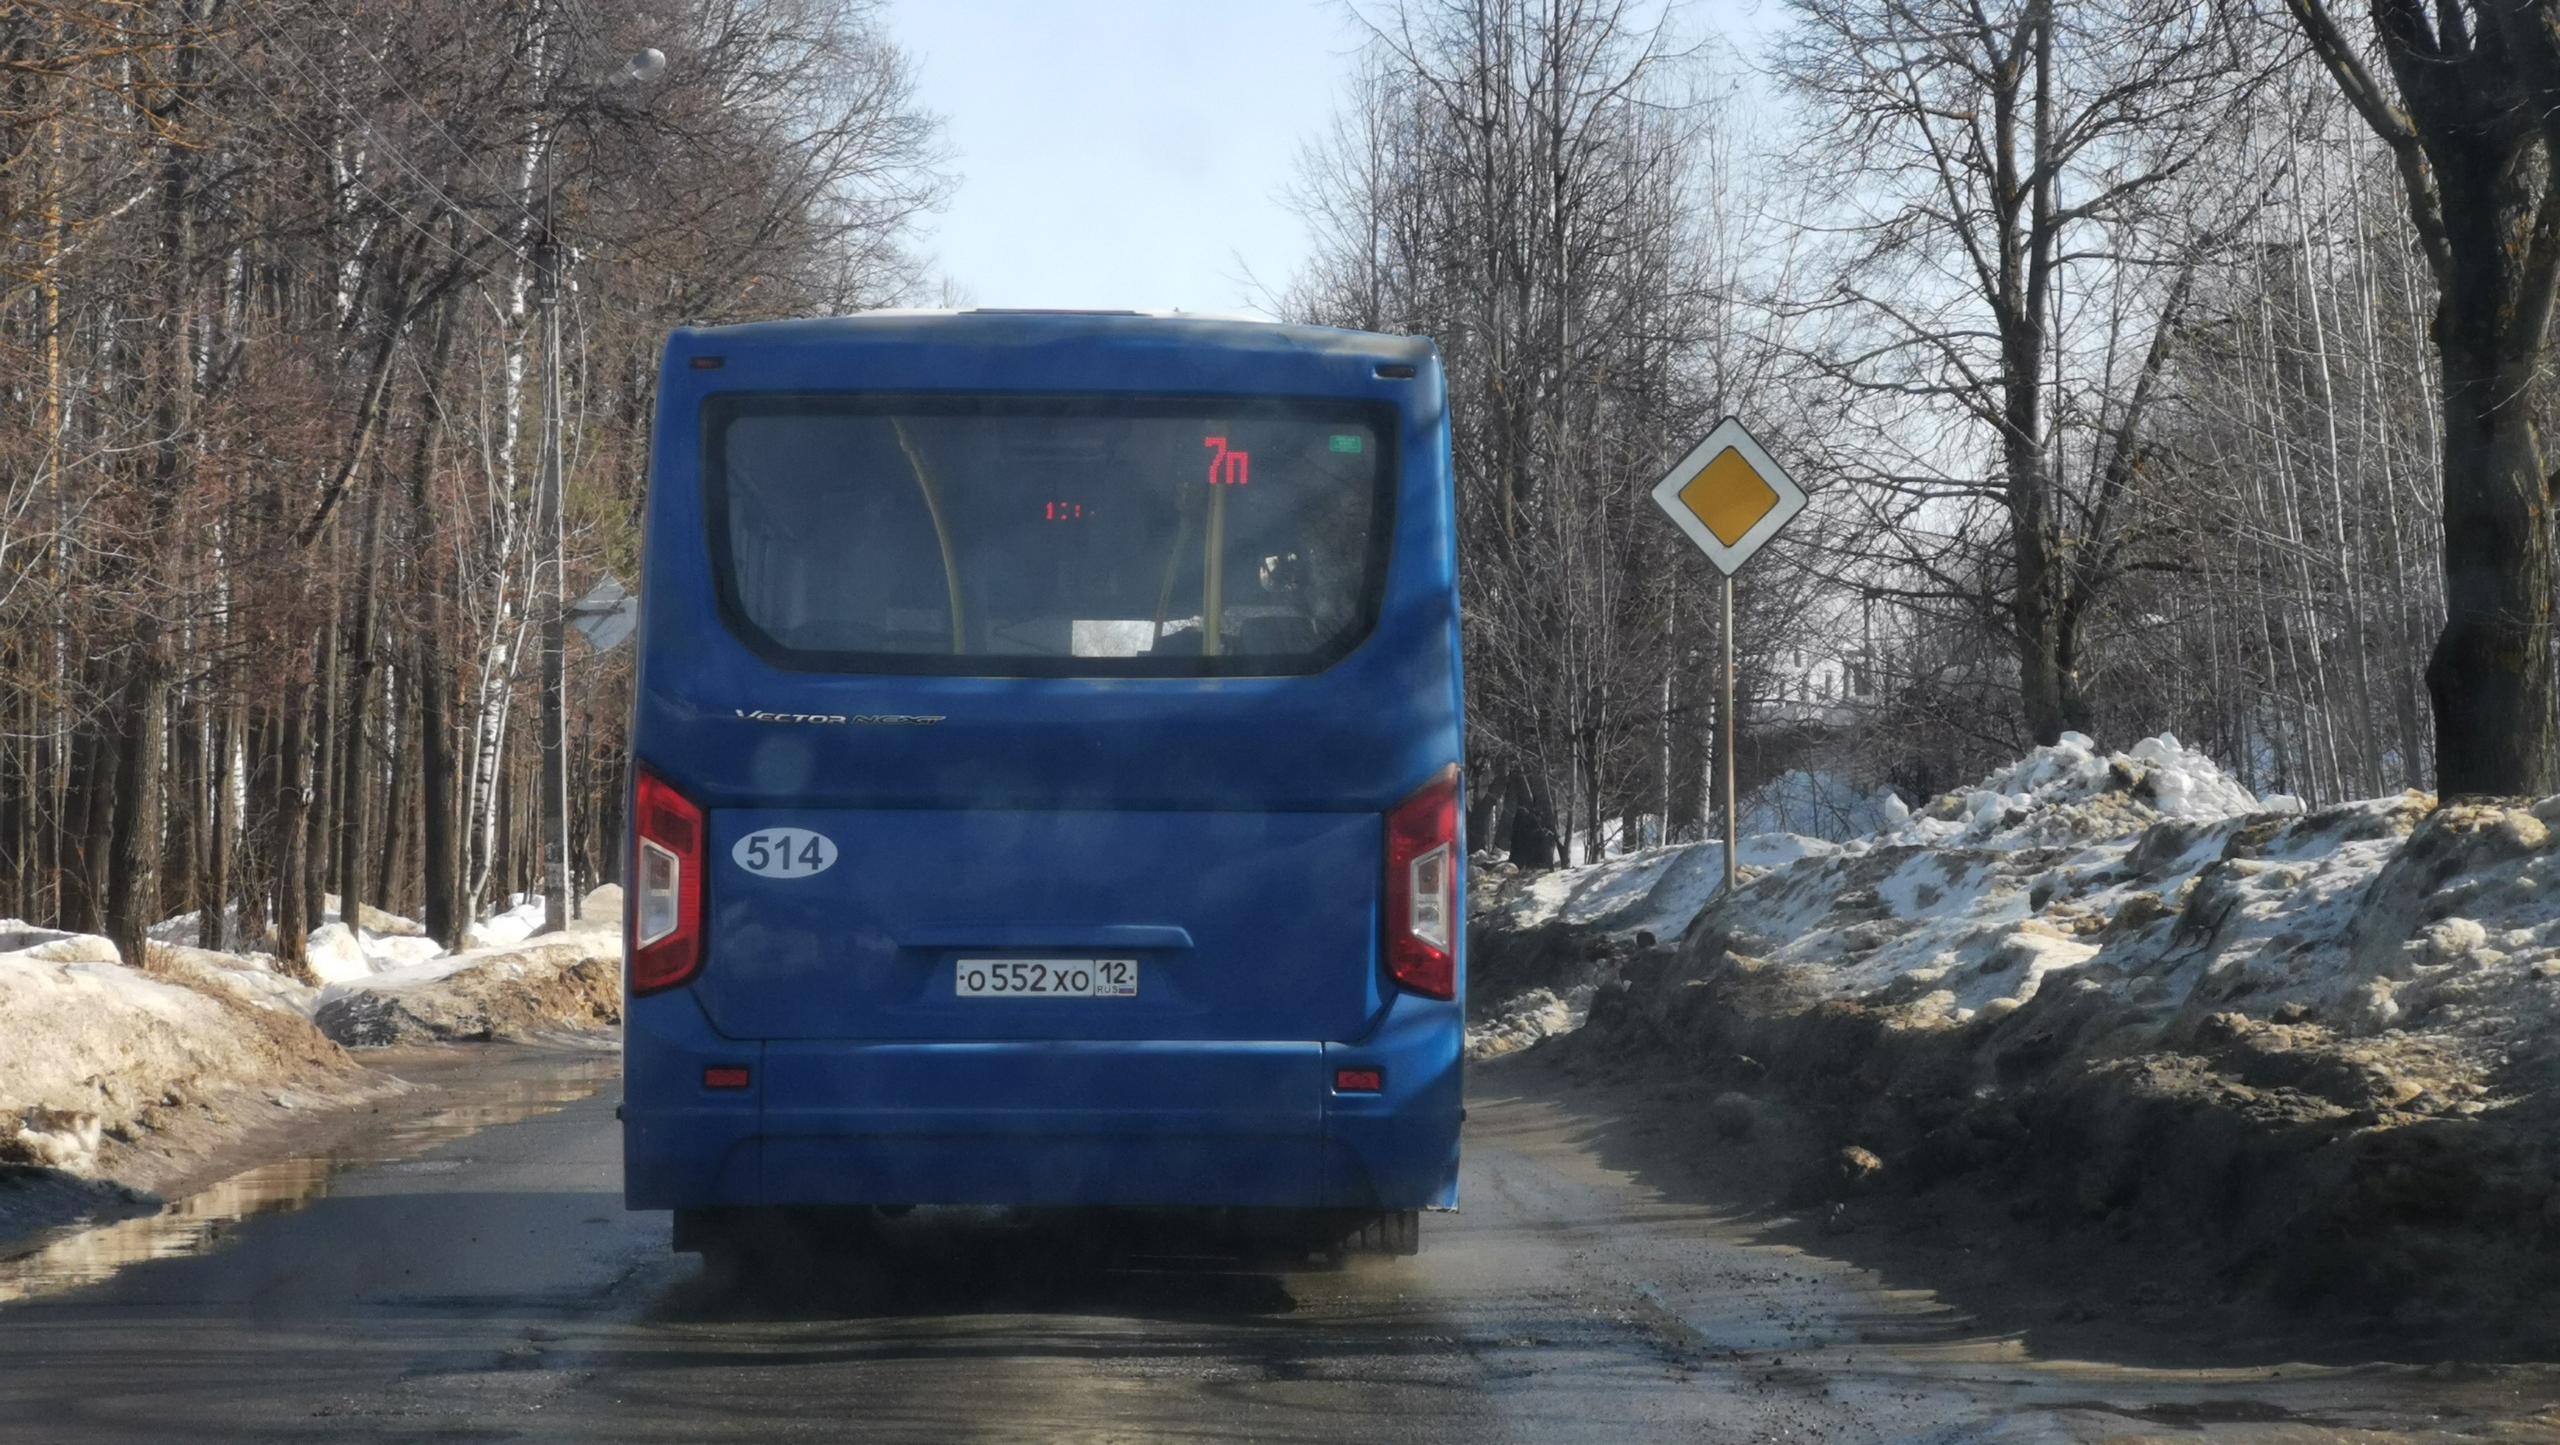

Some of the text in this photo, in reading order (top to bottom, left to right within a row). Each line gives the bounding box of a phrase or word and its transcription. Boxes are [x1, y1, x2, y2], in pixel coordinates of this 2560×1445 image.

[734, 708, 946, 725] VECTOR NEXT
[746, 835, 823, 870] 514
[1100, 962, 1127, 984] 12
[1097, 985, 1118, 994] RUS
